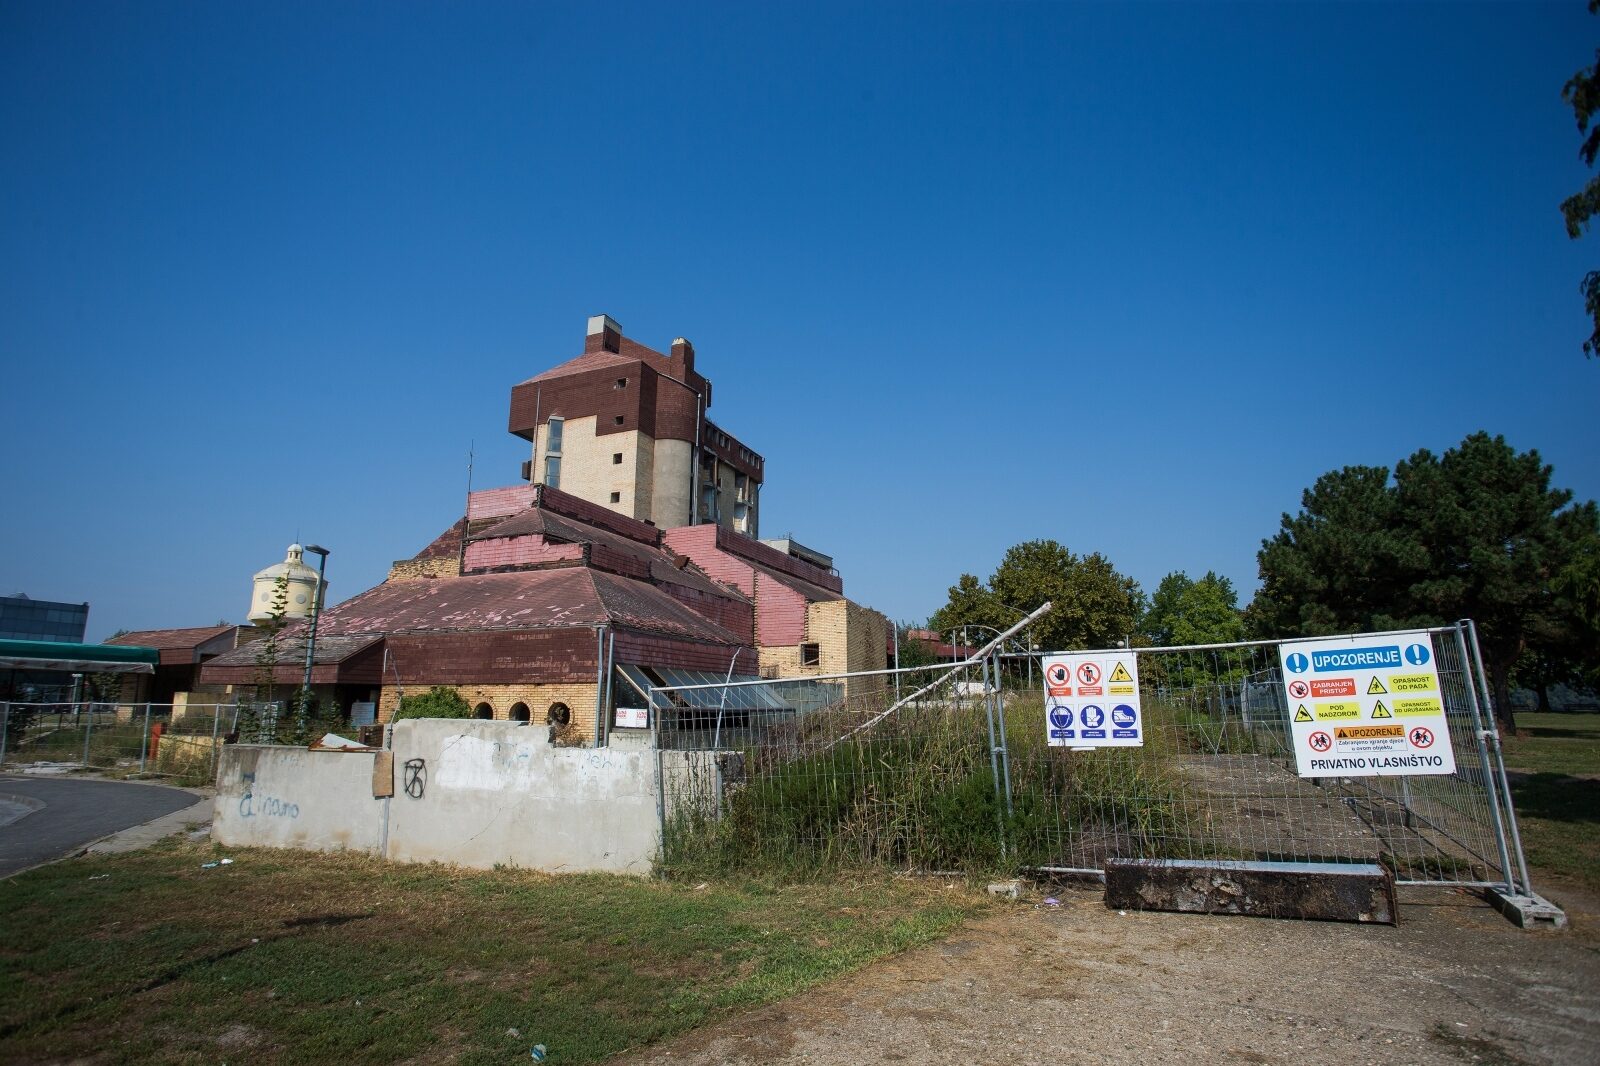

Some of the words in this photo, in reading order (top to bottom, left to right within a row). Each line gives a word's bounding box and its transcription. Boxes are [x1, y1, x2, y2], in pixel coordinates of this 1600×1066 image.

[1314, 650, 1400, 668] UPOZORENJE
[1312, 681, 1353, 689] ZABRANJEN
[1392, 676, 1430, 684] OPASNOST
[1349, 727, 1402, 738] UPOZORENJE
[1310, 757, 1366, 770] PRIVATNO
[1369, 753, 1443, 769] VLASNIŠTVO
